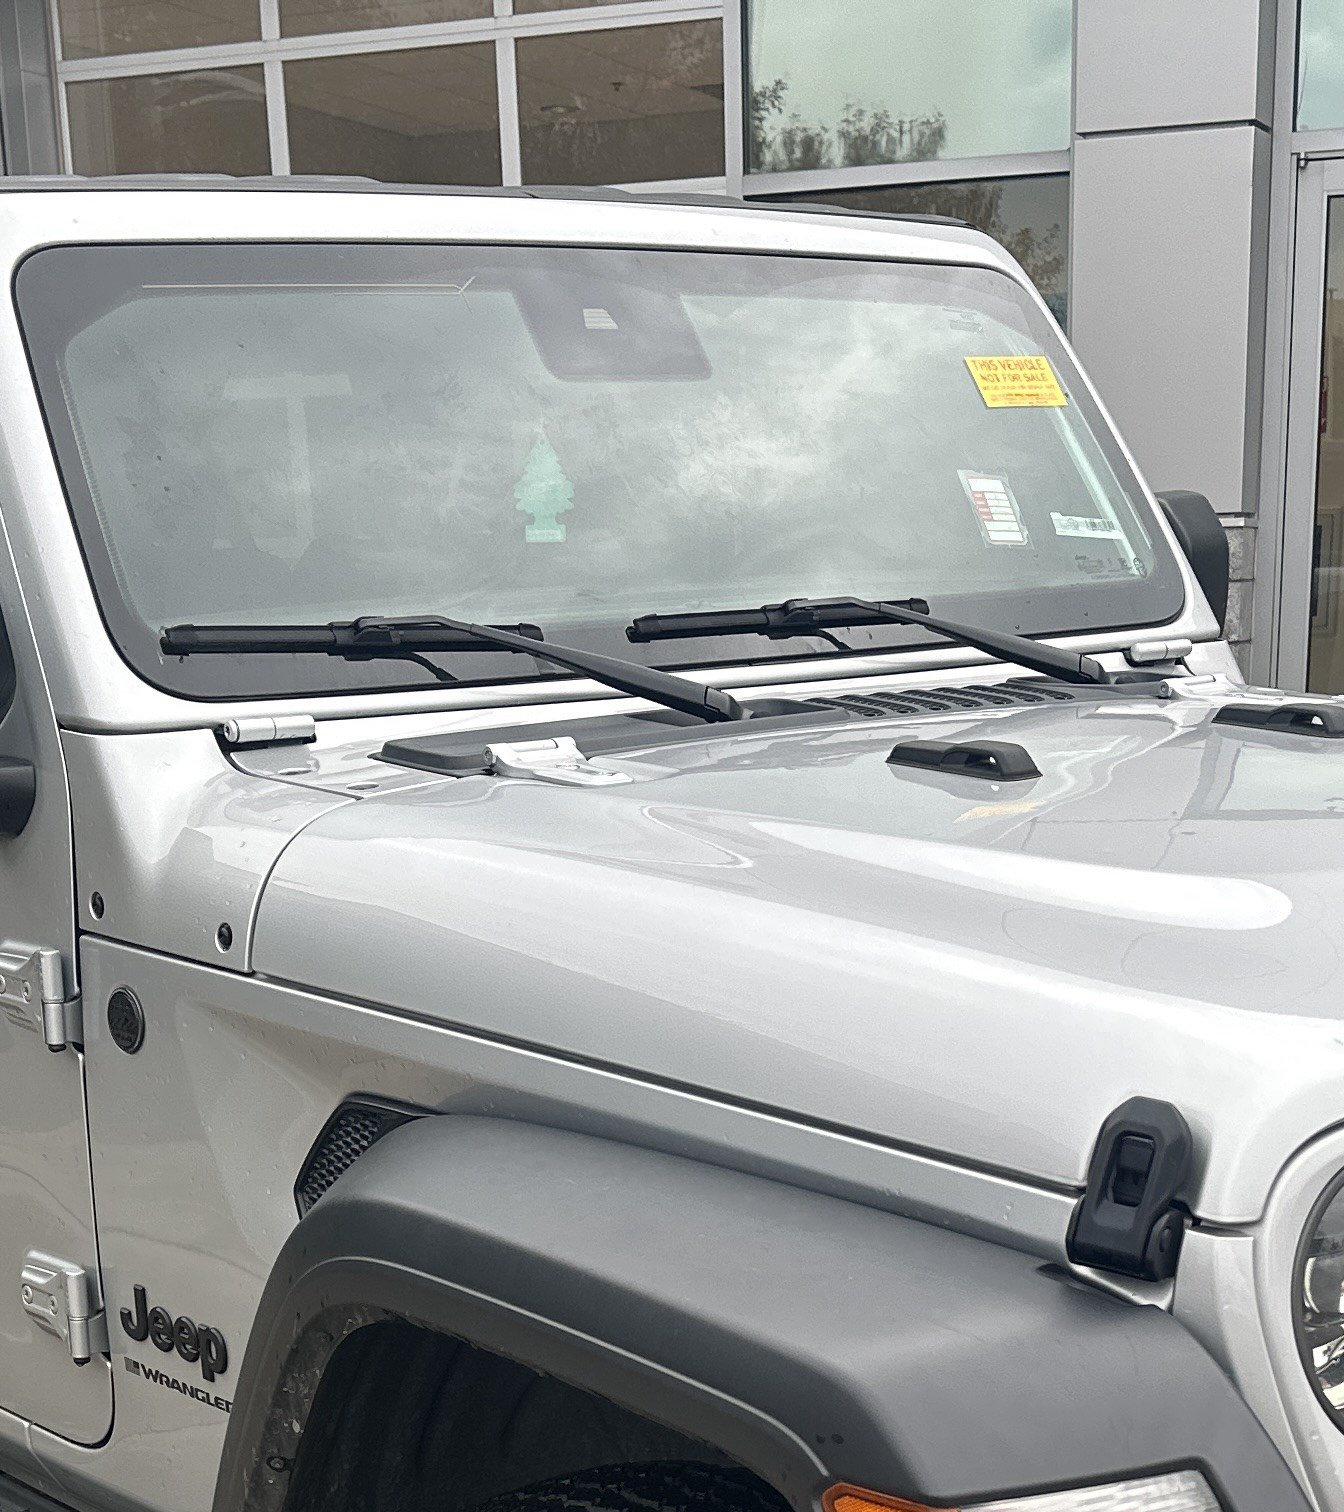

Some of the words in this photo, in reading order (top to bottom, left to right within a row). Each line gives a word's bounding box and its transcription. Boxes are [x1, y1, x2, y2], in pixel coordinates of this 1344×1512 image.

[970, 359, 998, 371] THIS
[998, 358, 1046, 371] VEHICLE
[979, 373, 1001, 383] NOT
[1002, 373, 1021, 383] FOR
[1023, 372, 1049, 382] SALE
[120, 1284, 228, 1383] Jeep
